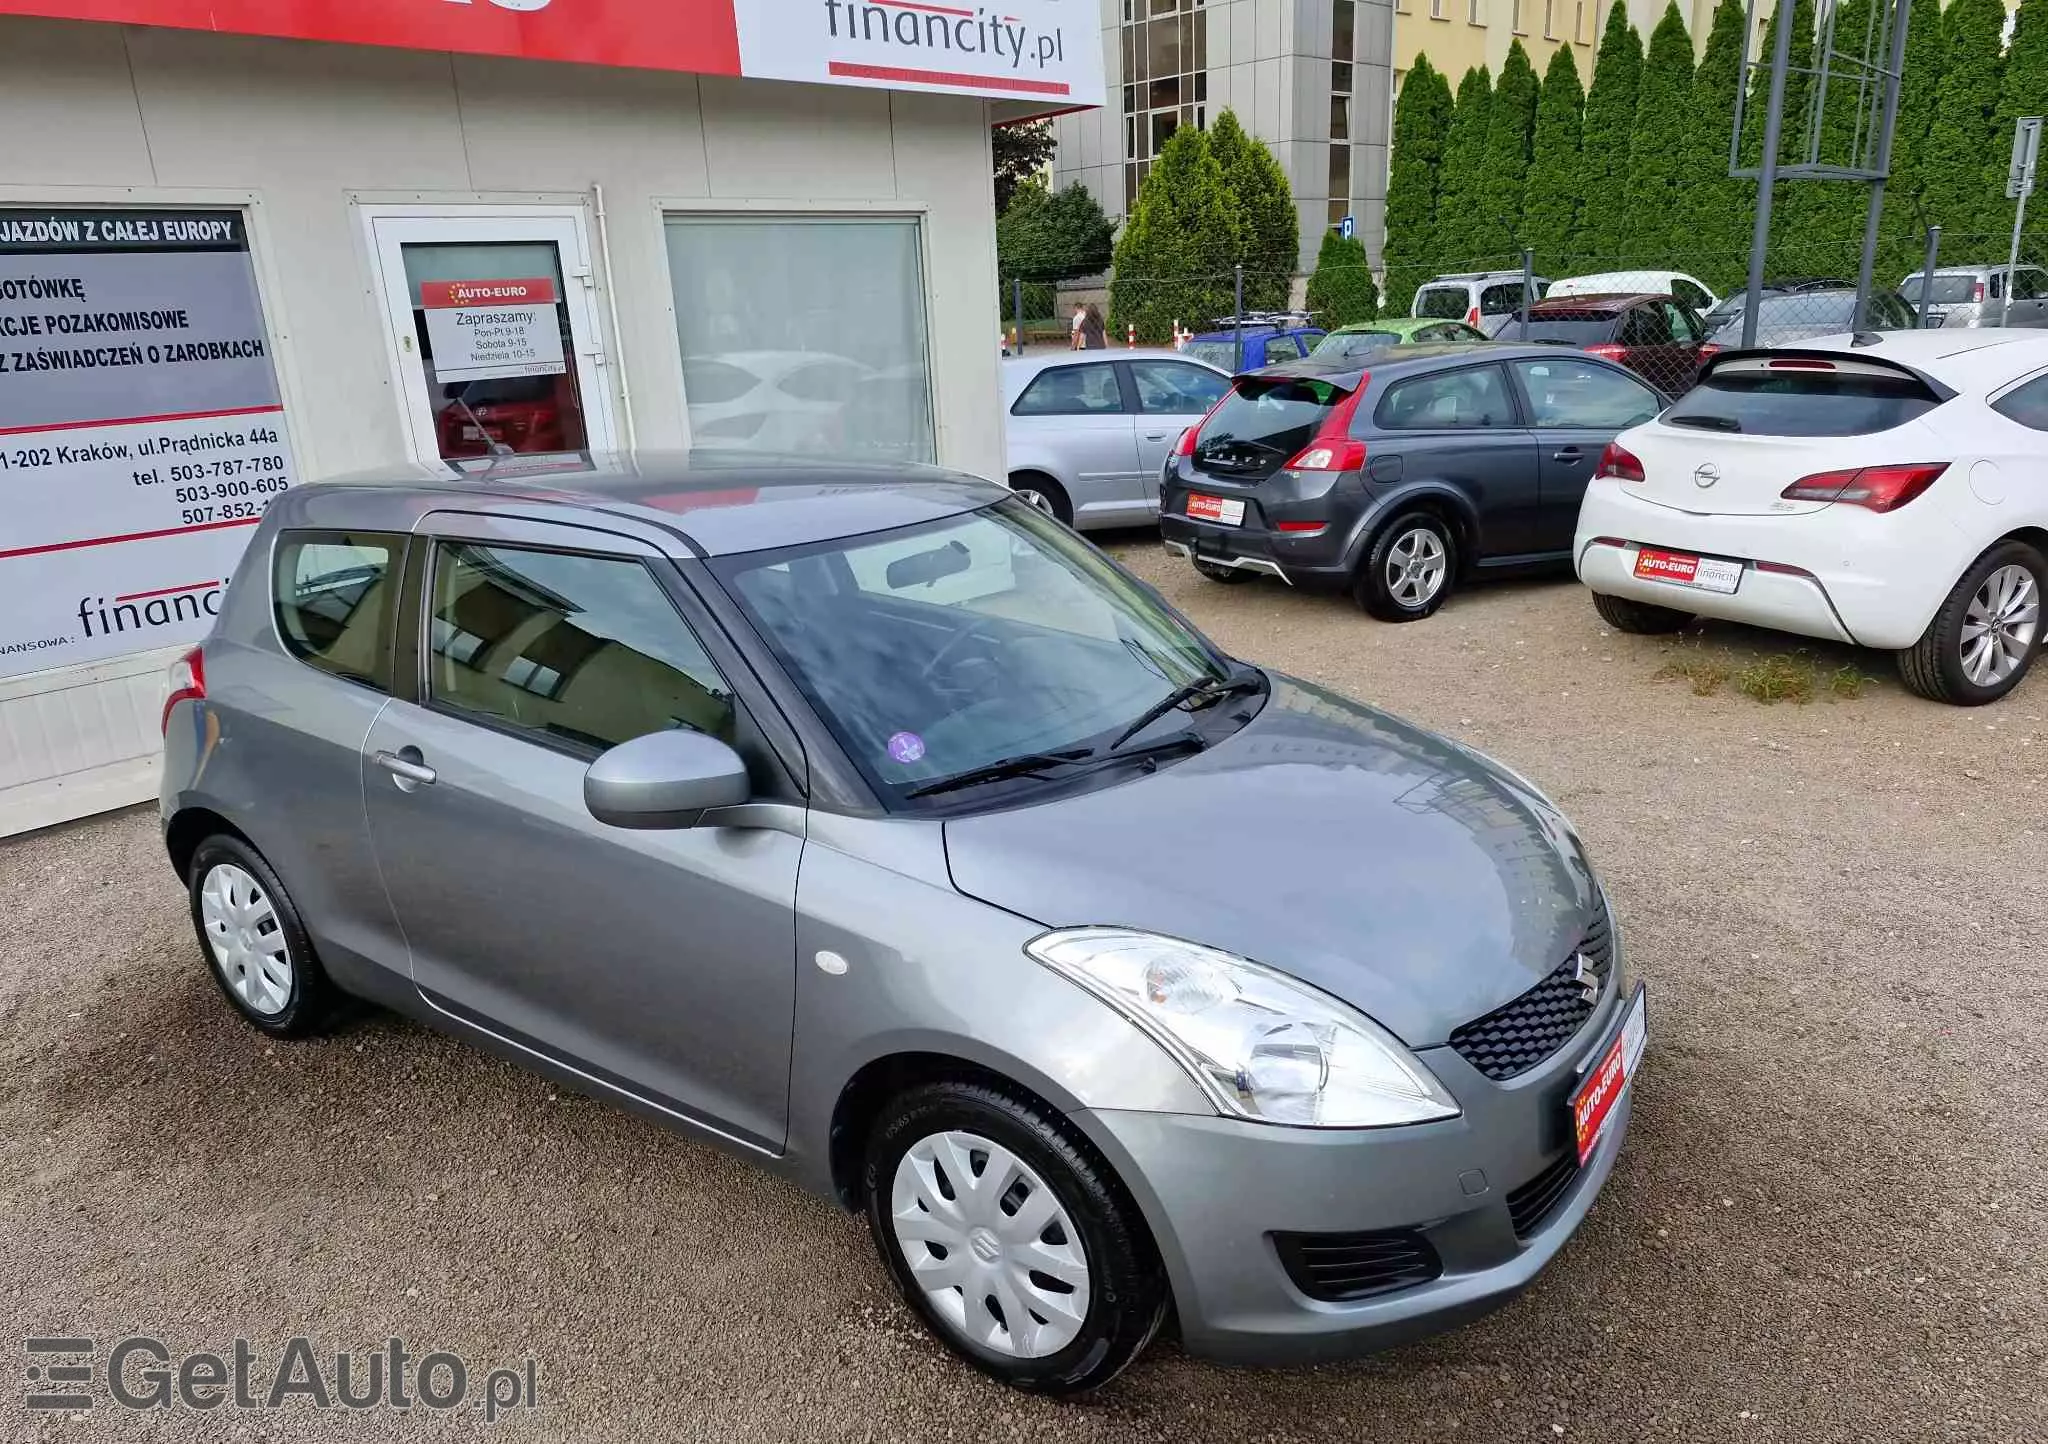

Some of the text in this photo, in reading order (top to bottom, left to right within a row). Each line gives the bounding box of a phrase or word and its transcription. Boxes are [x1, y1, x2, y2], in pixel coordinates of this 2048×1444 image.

[826, 0, 1063, 68] financity.pl
[84, 221, 98, 241] Z
[101, 220, 160, 241] CAŁEJ
[163, 221, 232, 241] EUROPY
[457, 286, 527, 299] AUTO-EURO
[44, 310, 189, 335] POZAKOMISOWE
[455, 310, 537, 328] Zapraszamy:
[505, 327, 525, 335] 9-18
[11, 342, 144, 372] ZAŚWIADCZEŃ
[148, 348, 160, 364] O
[163, 339, 265, 363] ZAROBKACH
[475, 338, 527, 350] Sobota 9-15
[512, 348, 536, 359] 10-15
[56, 442, 133, 465] Kraków,
[138, 430, 245, 457] ul.Prądnicka
[249, 427, 278, 445] 44a
[132, 455, 284, 486] tel. 503-787-780
[176, 476, 289, 503] 503-900-605
[1642, 558, 1695, 574] AUTO-EURO
[78, 578, 230, 638] financ
[1579, 1050, 1621, 1127] AUTO-EURO
